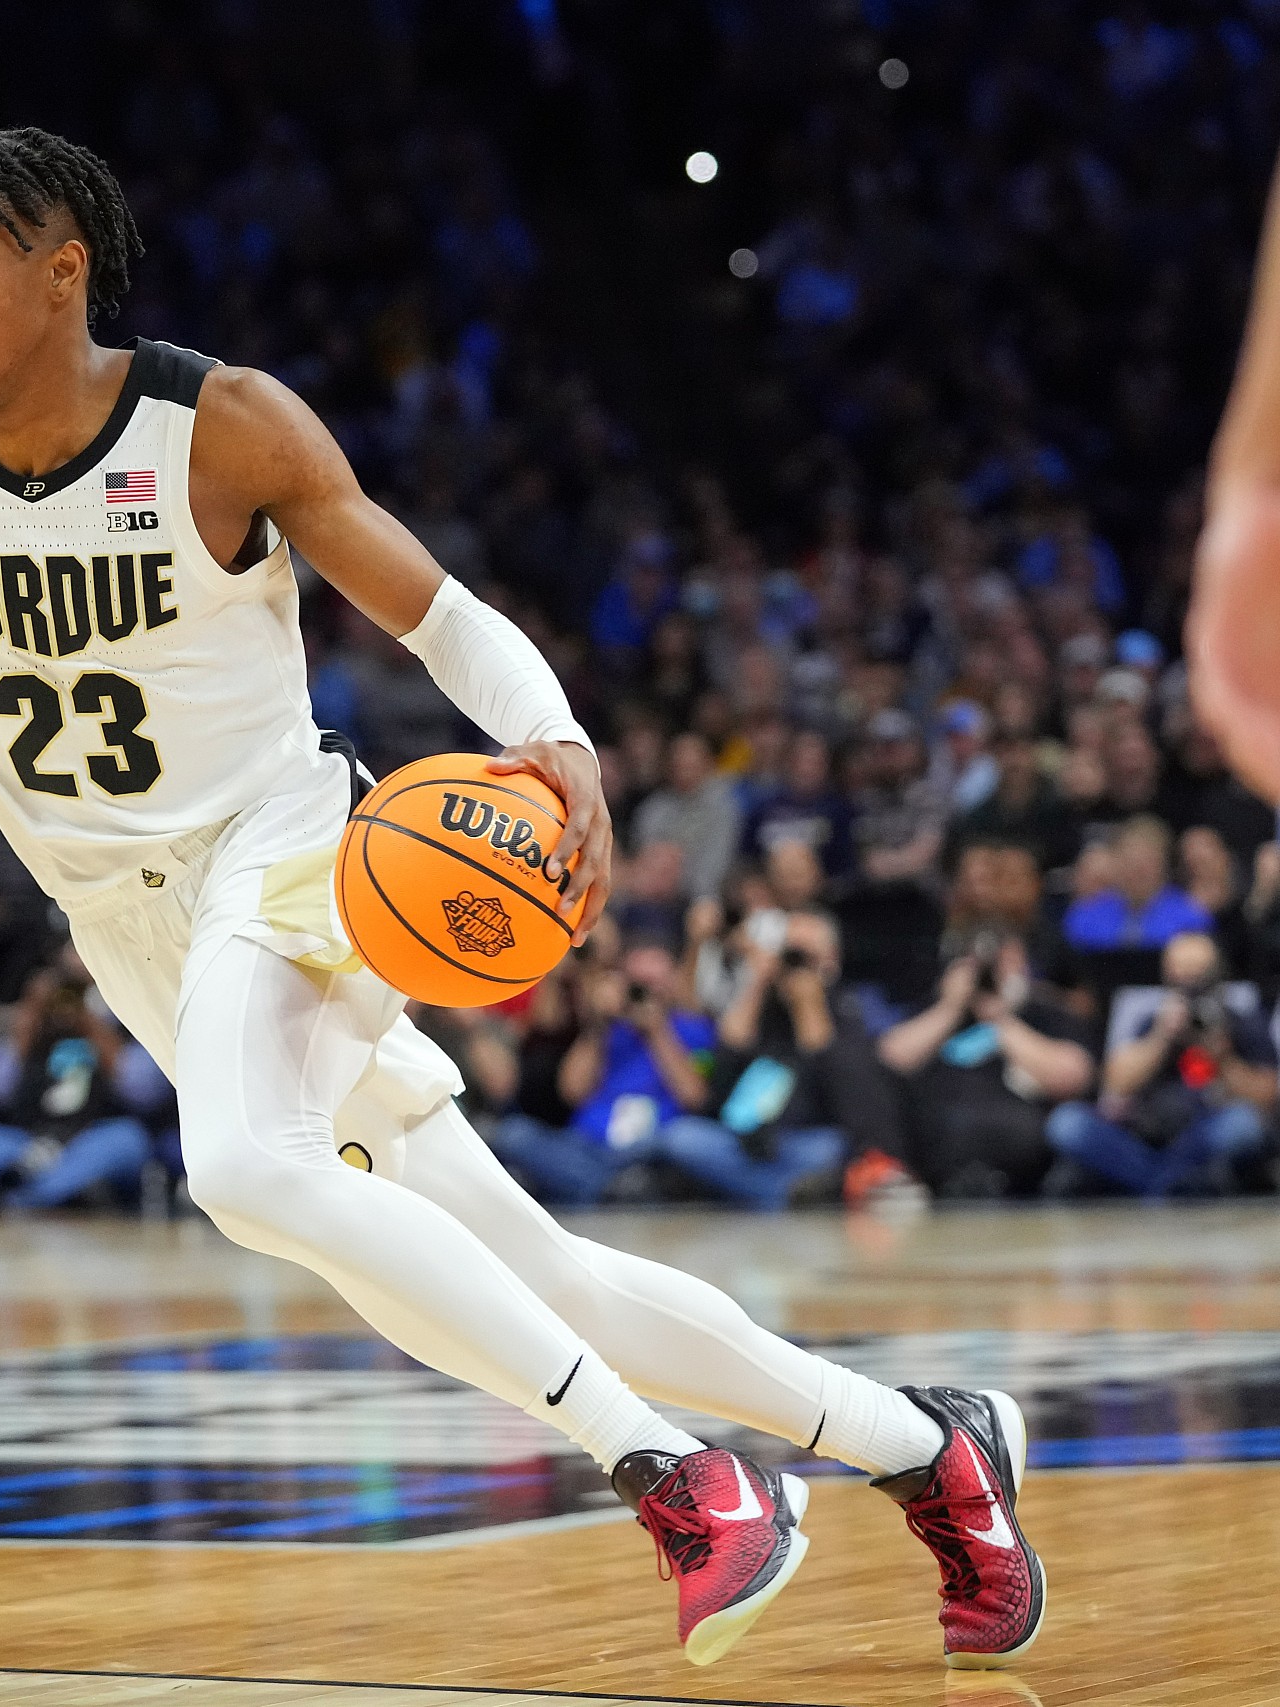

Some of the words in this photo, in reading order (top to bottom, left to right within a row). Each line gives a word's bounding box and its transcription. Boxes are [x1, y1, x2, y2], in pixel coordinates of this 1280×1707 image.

[23, 482, 45, 496] P
[491, 851, 515, 867] EVO
[467, 900, 510, 933] FINAL
[455, 913, 501, 944] FOUR
